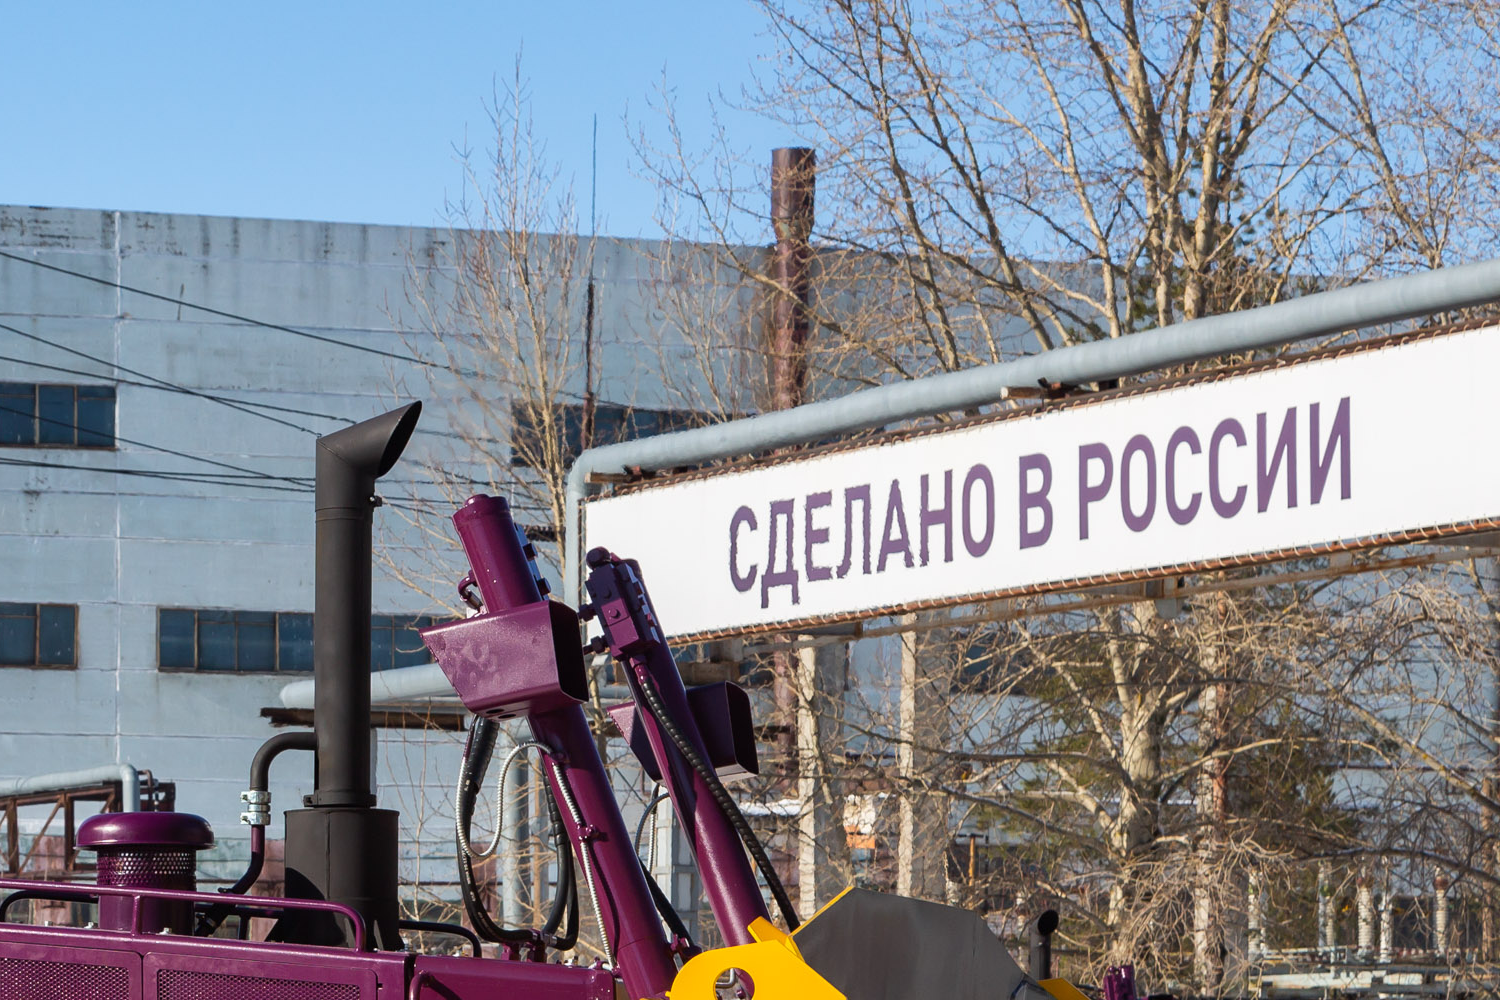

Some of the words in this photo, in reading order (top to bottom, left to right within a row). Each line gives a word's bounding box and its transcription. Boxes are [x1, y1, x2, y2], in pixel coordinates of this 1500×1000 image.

[729, 464, 996, 609] СДЕЛАНО
[1019, 453, 1054, 550] В
[1079, 397, 1352, 540] РОССИИ
